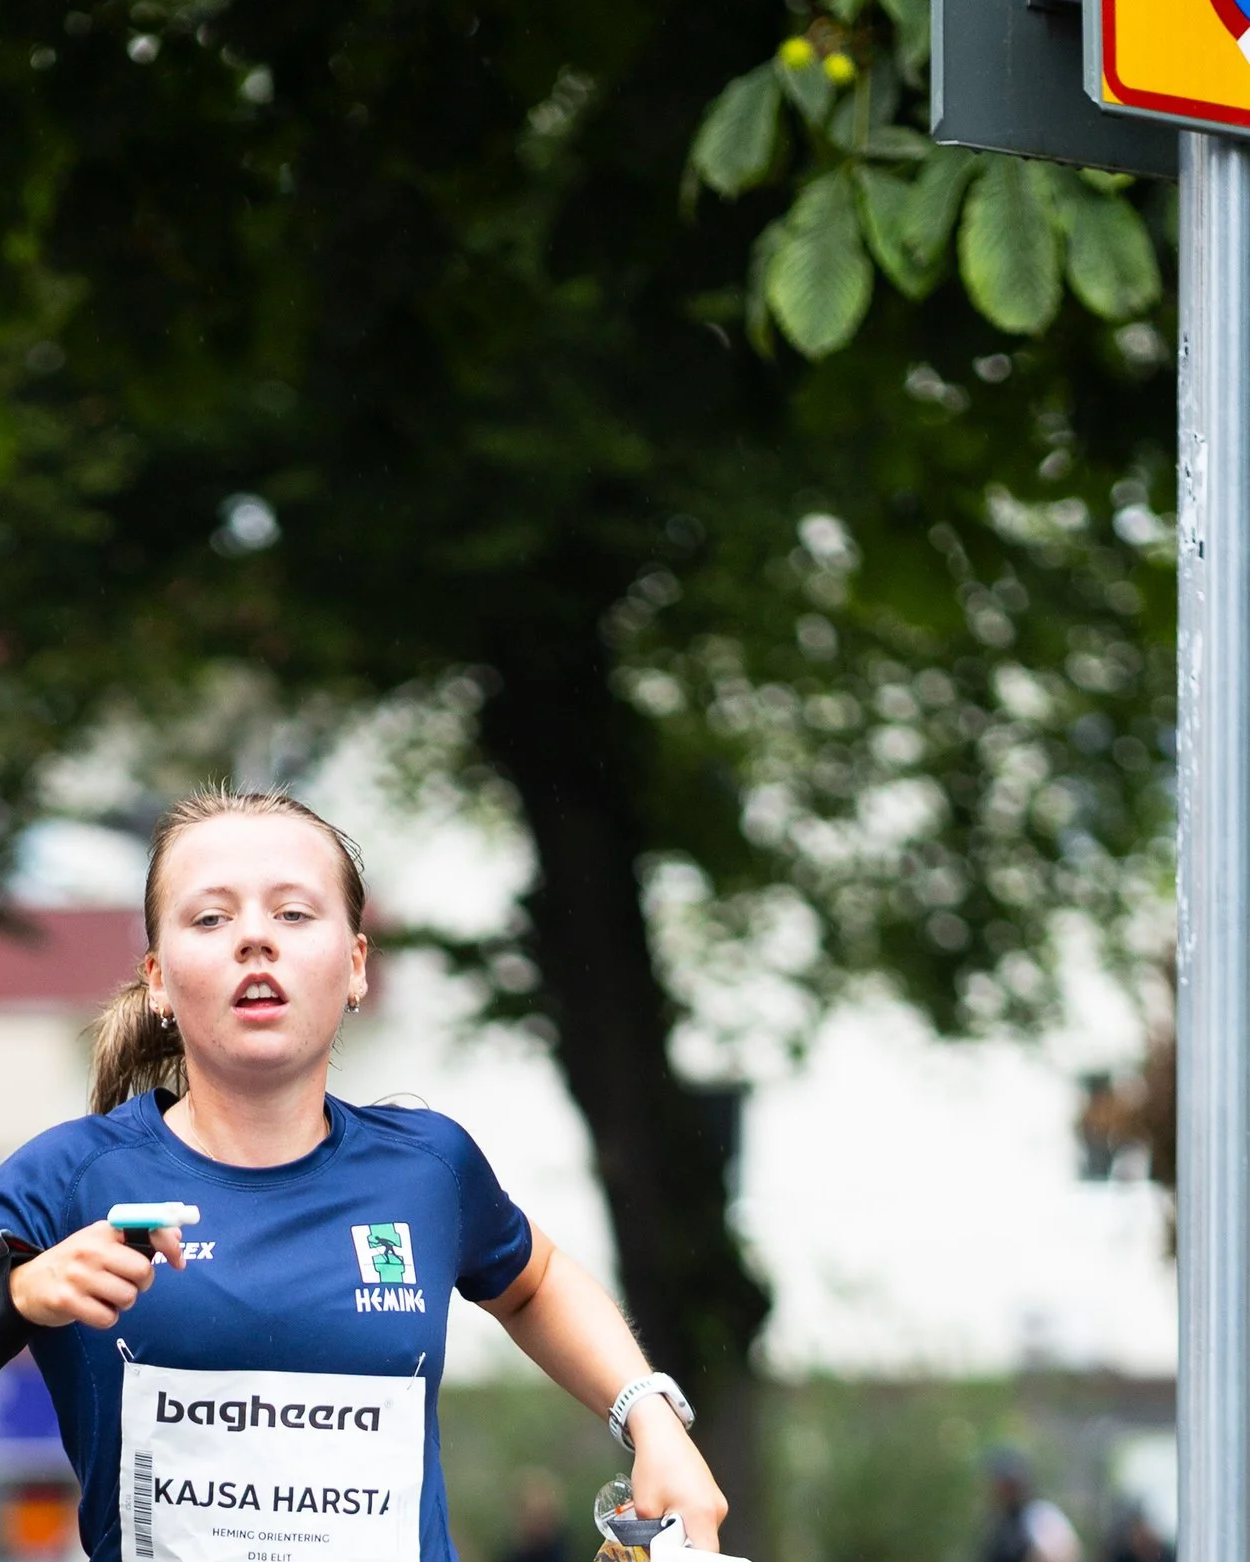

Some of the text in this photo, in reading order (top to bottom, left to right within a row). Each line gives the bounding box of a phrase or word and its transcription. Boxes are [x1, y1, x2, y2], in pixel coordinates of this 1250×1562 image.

[355, 1288, 426, 1313] HEMING
[156, 1390, 381, 1433] bagheera
[154, 1478, 261, 1511] KAJSA
[212, 1528, 330, 1543] HEMING ORIENTERING
[248, 1551, 292, 1562] D18 ELIT
